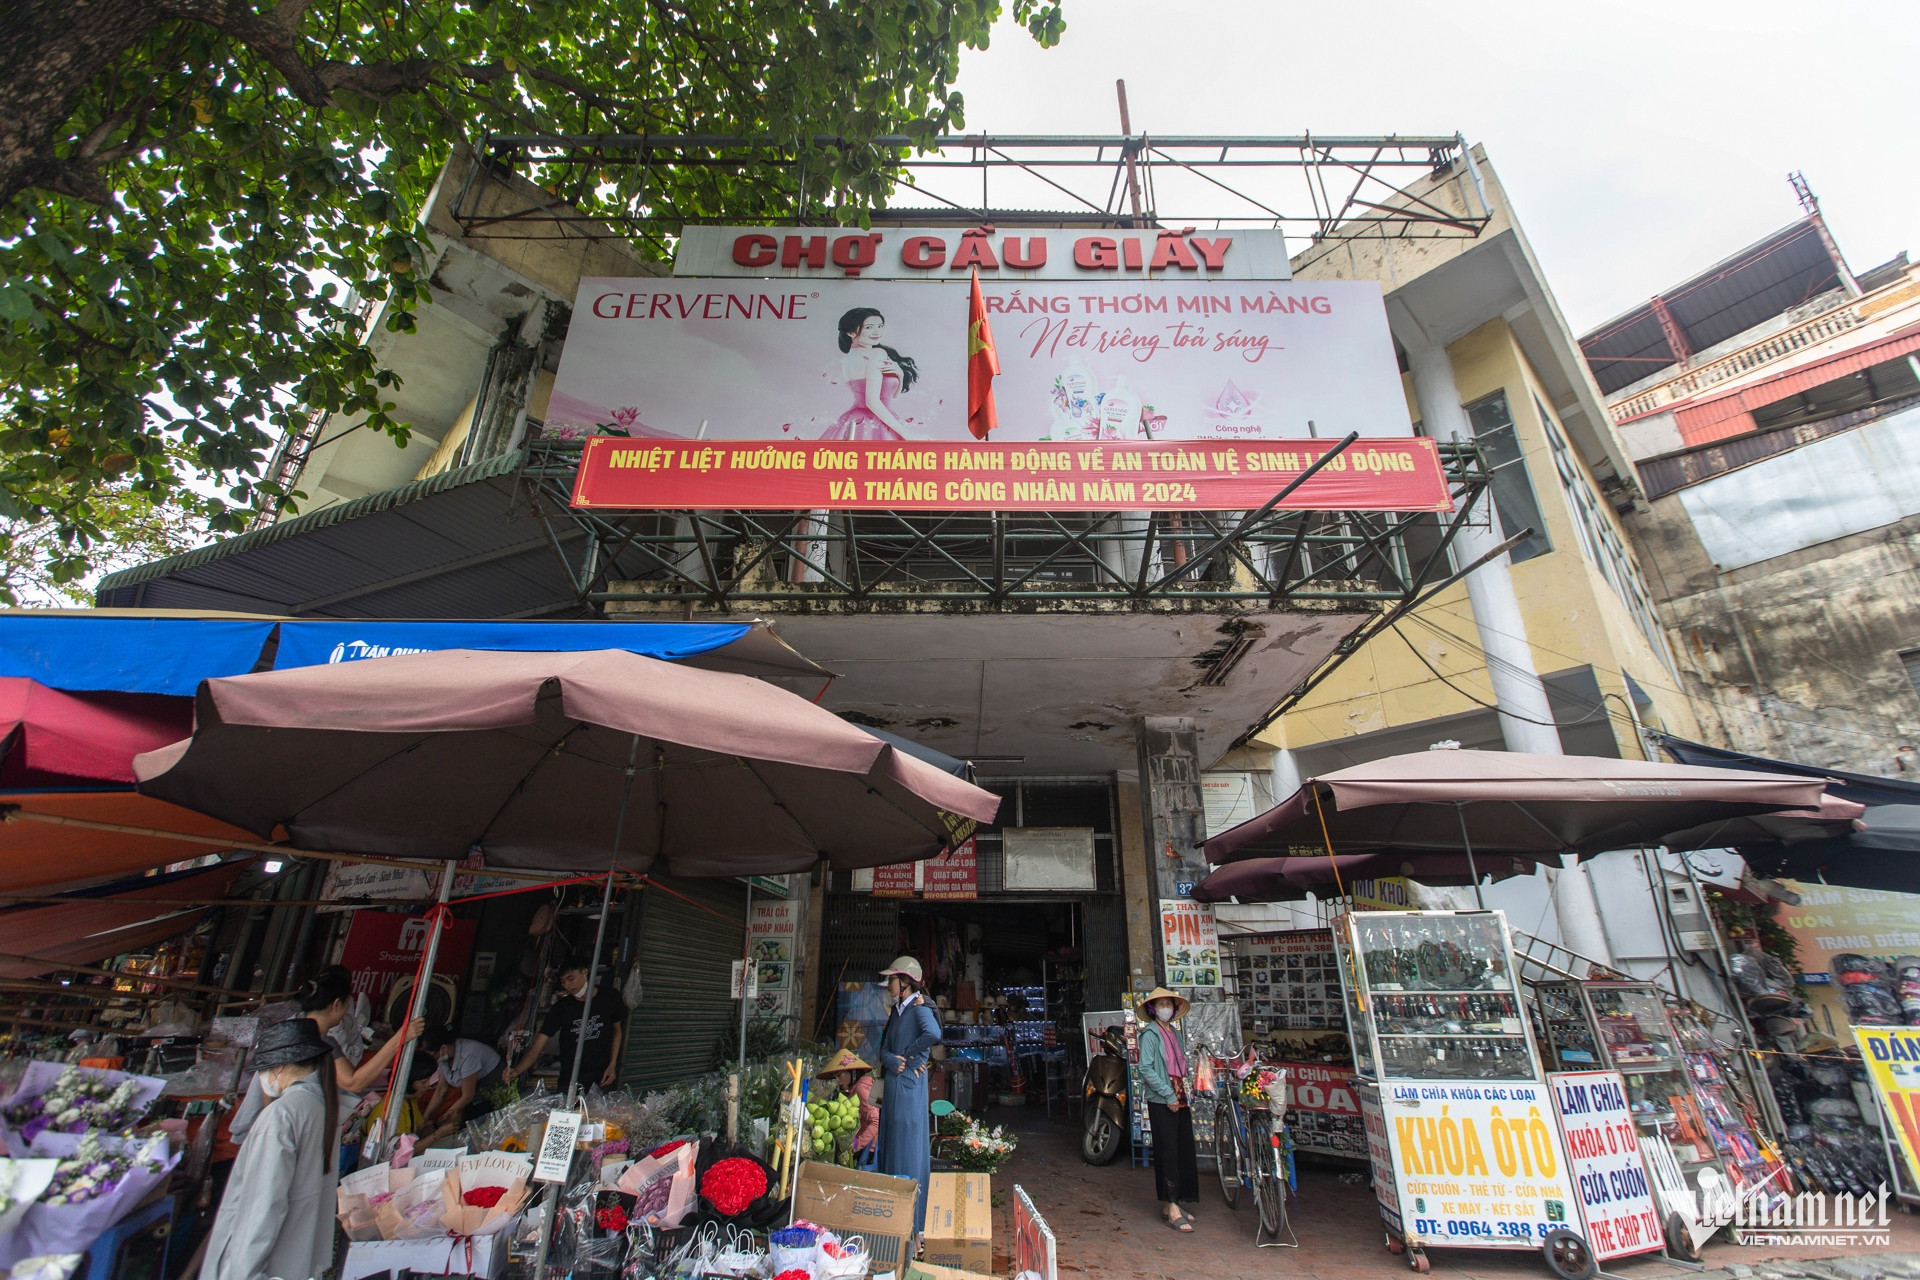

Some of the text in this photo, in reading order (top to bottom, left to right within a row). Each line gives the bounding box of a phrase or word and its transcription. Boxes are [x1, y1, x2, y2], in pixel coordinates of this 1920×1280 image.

[732, 224, 1234, 276] CHỢ CẦU GIẤY
[1078, 293, 1168, 314] THƠM
[1176, 295, 1232, 318] MỊN
[1240, 291, 1332, 314] MÀNG
[1020, 317, 1101, 359] Nét
[1091, 327, 1170, 363] riêng
[1213, 329, 1285, 363] sáng
[1215, 424, 1262, 435] Công nghệ
[609, 447, 675, 472] NHIỆT
[680, 447, 726, 472] LIỆT
[730, 445, 807, 469] HƯỞNG
[812, 448, 859, 469] ỨNG
[865, 448, 937, 470] THÁNG
[944, 448, 1004, 470] HÀNH
[1010, 448, 1072, 474] ĐỘNG
[1077, 446, 1105, 471] VỀ
[1111, 452, 1143, 470] AN
[1147, 448, 1208, 471] TOÀN
[1215, 448, 1240, 475] VỆ
[1246, 452, 1299, 471] SINH
[1351, 449, 1416, 475] ĐỘNG
[829, 478, 1198, 502] VÀ THÁNG CÔNG NHÂN NĂM 2024
[1179, 883, 1193, 895] 37
[758, 906, 790, 917] TRÁI CÂY
[1175, 903, 1200, 912] THAY
[752, 919, 794, 935] NHẬP KHẨU
[1163, 913, 1201, 946] PIN
[1815, 935, 1872, 951] TRANG
[1298, 1067, 1331, 1082] CHÌA
[1394, 1085, 1419, 1100] LÀM
[1421, 1087, 1449, 1100] CHÌA
[1450, 1086, 1482, 1101] KHÓA
[1484, 1086, 1508, 1101] CÁC
[1511, 1089, 1536, 1103] LOẠI
[1556, 1077, 1626, 1115] LÀM CHÌA
[1394, 1104, 1557, 1179] KHÓA ÔTÔ
[1567, 1117, 1637, 1160] KHÓA Ô TÔ
[484, 1158, 513, 1173] LOVE
[1406, 1179, 1564, 1198] CỬA CUỐN THẺ TỪ CỬA NHÀ
[1580, 1157, 1649, 1207] CỬA CUỐN
[1441, 1201, 1456, 1215] XE
[1457, 1199, 1481, 1215] MÁY
[1415, 1218, 1442, 1235] ĐT:
[1447, 1219, 1493, 1236] 0964
[1498, 1221, 1532, 1238] 388
[1590, 1206, 1658, 1254] THẺ CHÍP TỪ
